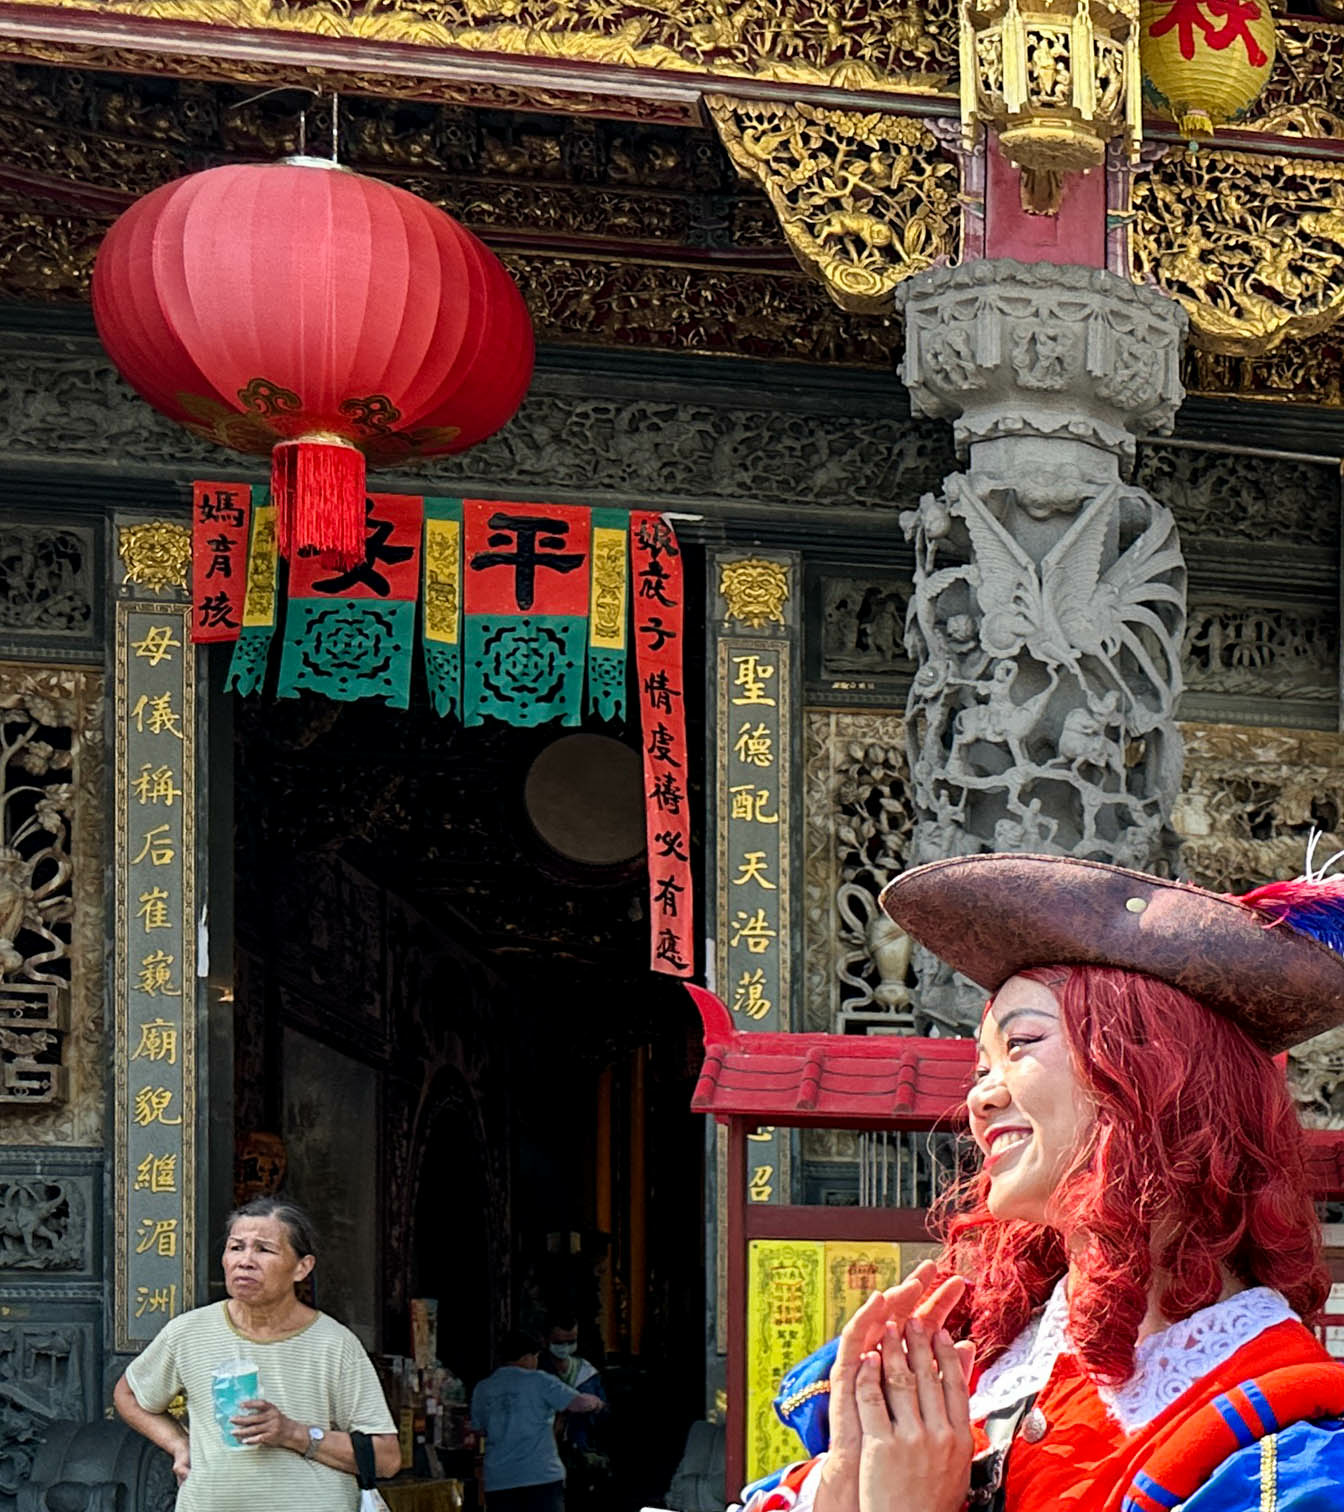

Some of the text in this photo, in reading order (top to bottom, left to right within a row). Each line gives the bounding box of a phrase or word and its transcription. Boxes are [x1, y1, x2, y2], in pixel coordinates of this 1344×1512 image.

[131, 625, 184, 1320] 母儀稱后崔巍廟貌繼湄洲
